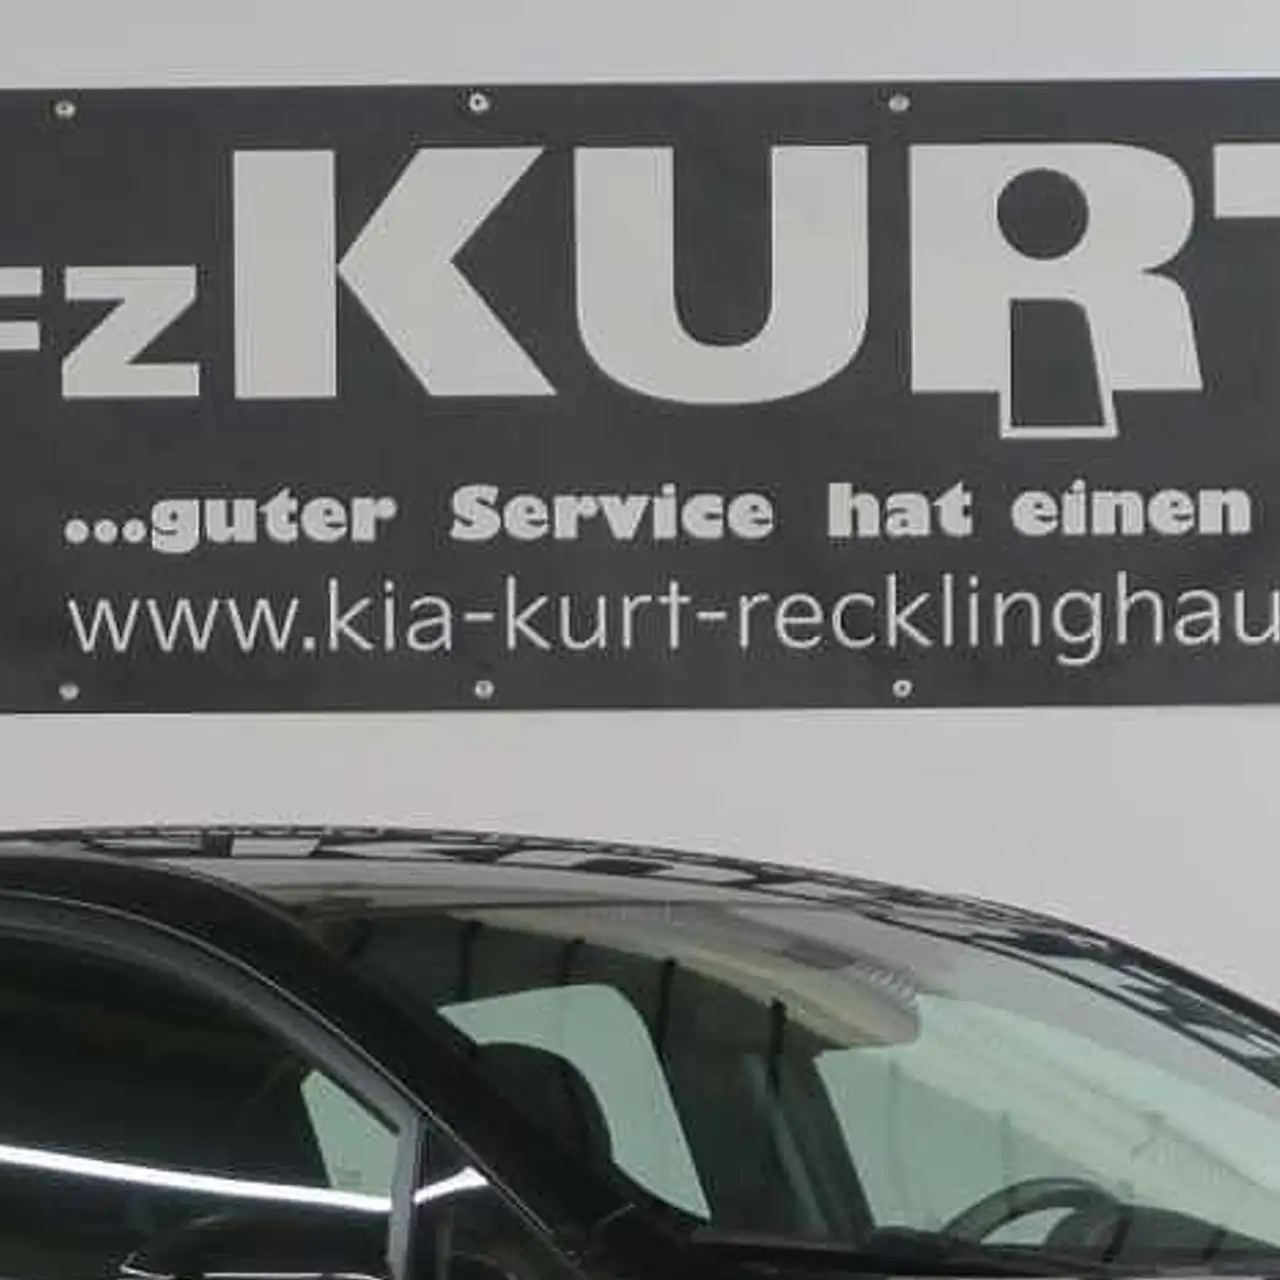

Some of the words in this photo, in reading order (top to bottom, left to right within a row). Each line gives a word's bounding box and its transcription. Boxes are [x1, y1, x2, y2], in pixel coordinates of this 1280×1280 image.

[64, 488, 397, 554] ...guter
[449, 483, 774, 541] Service
[827, 481, 973, 538] hat
[1011, 479, 1252, 537] einen
